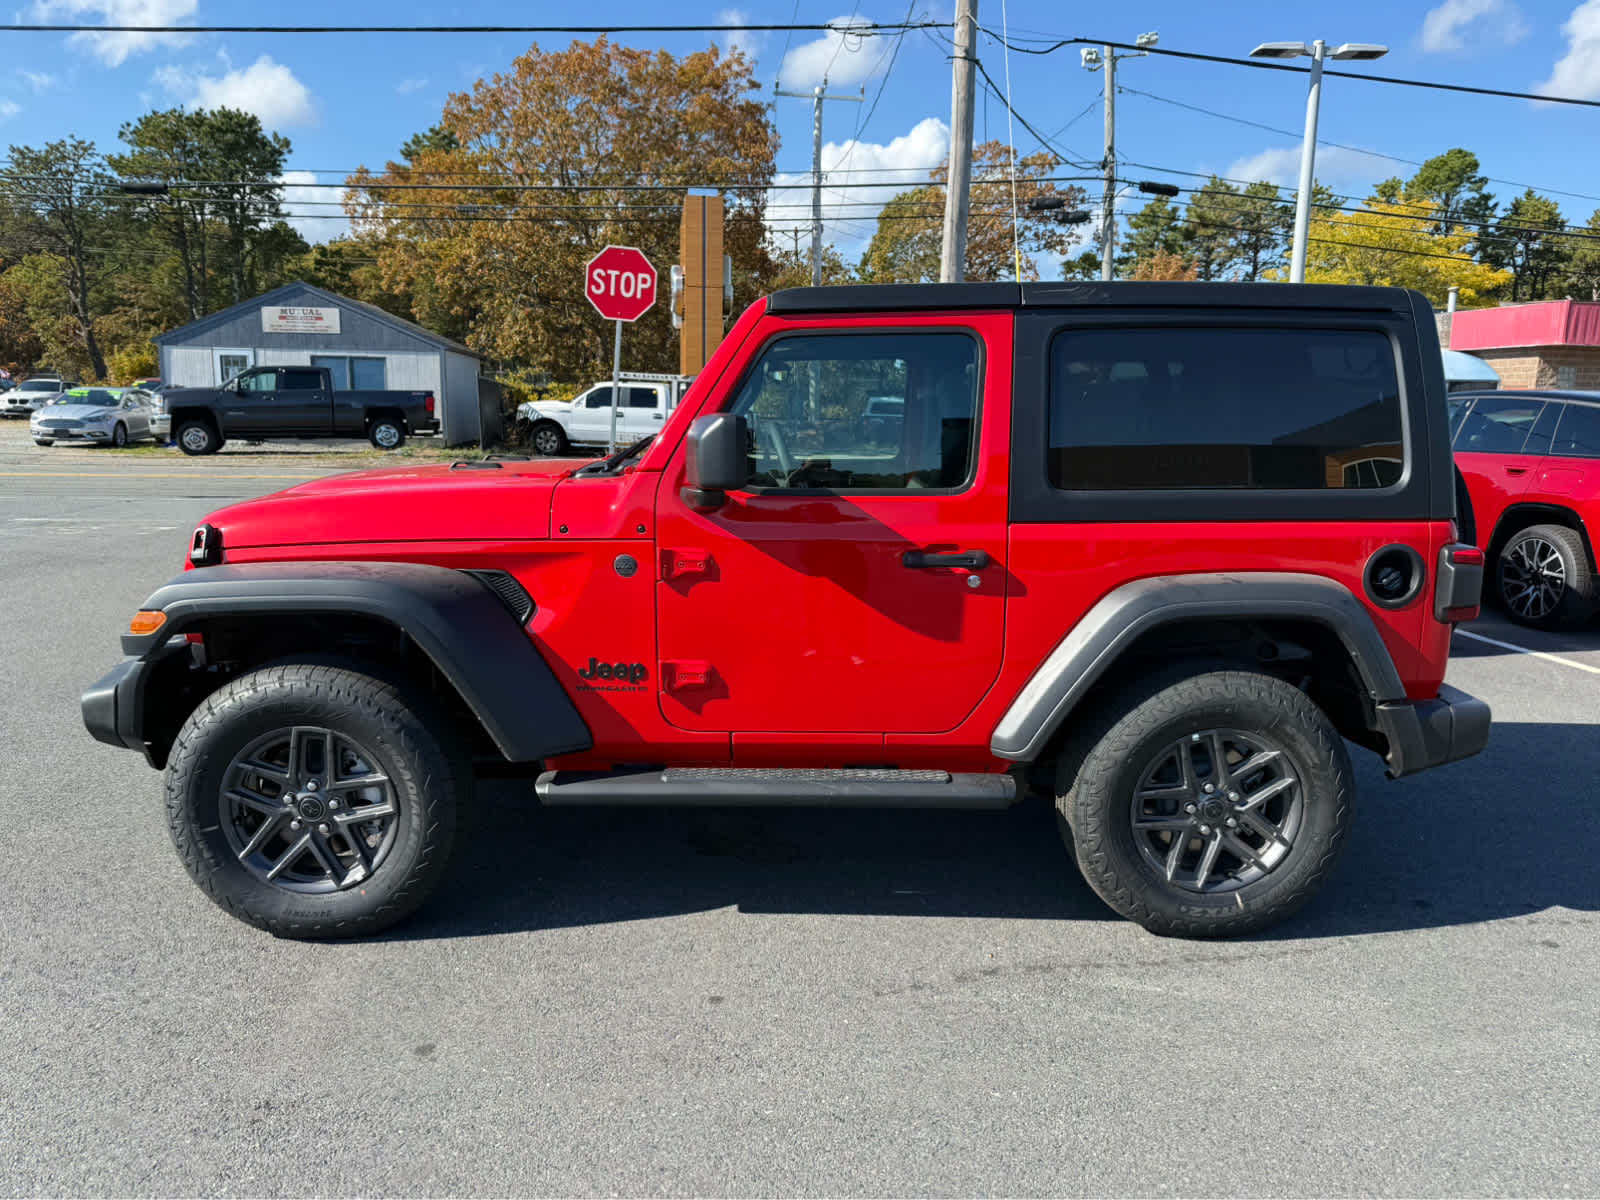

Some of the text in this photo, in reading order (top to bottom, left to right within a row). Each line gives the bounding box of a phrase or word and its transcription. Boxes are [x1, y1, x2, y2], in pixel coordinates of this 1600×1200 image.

[592, 269, 652, 299] STOP
[280, 308, 321, 316] MUUAL
[578, 657, 645, 684] Jeep
